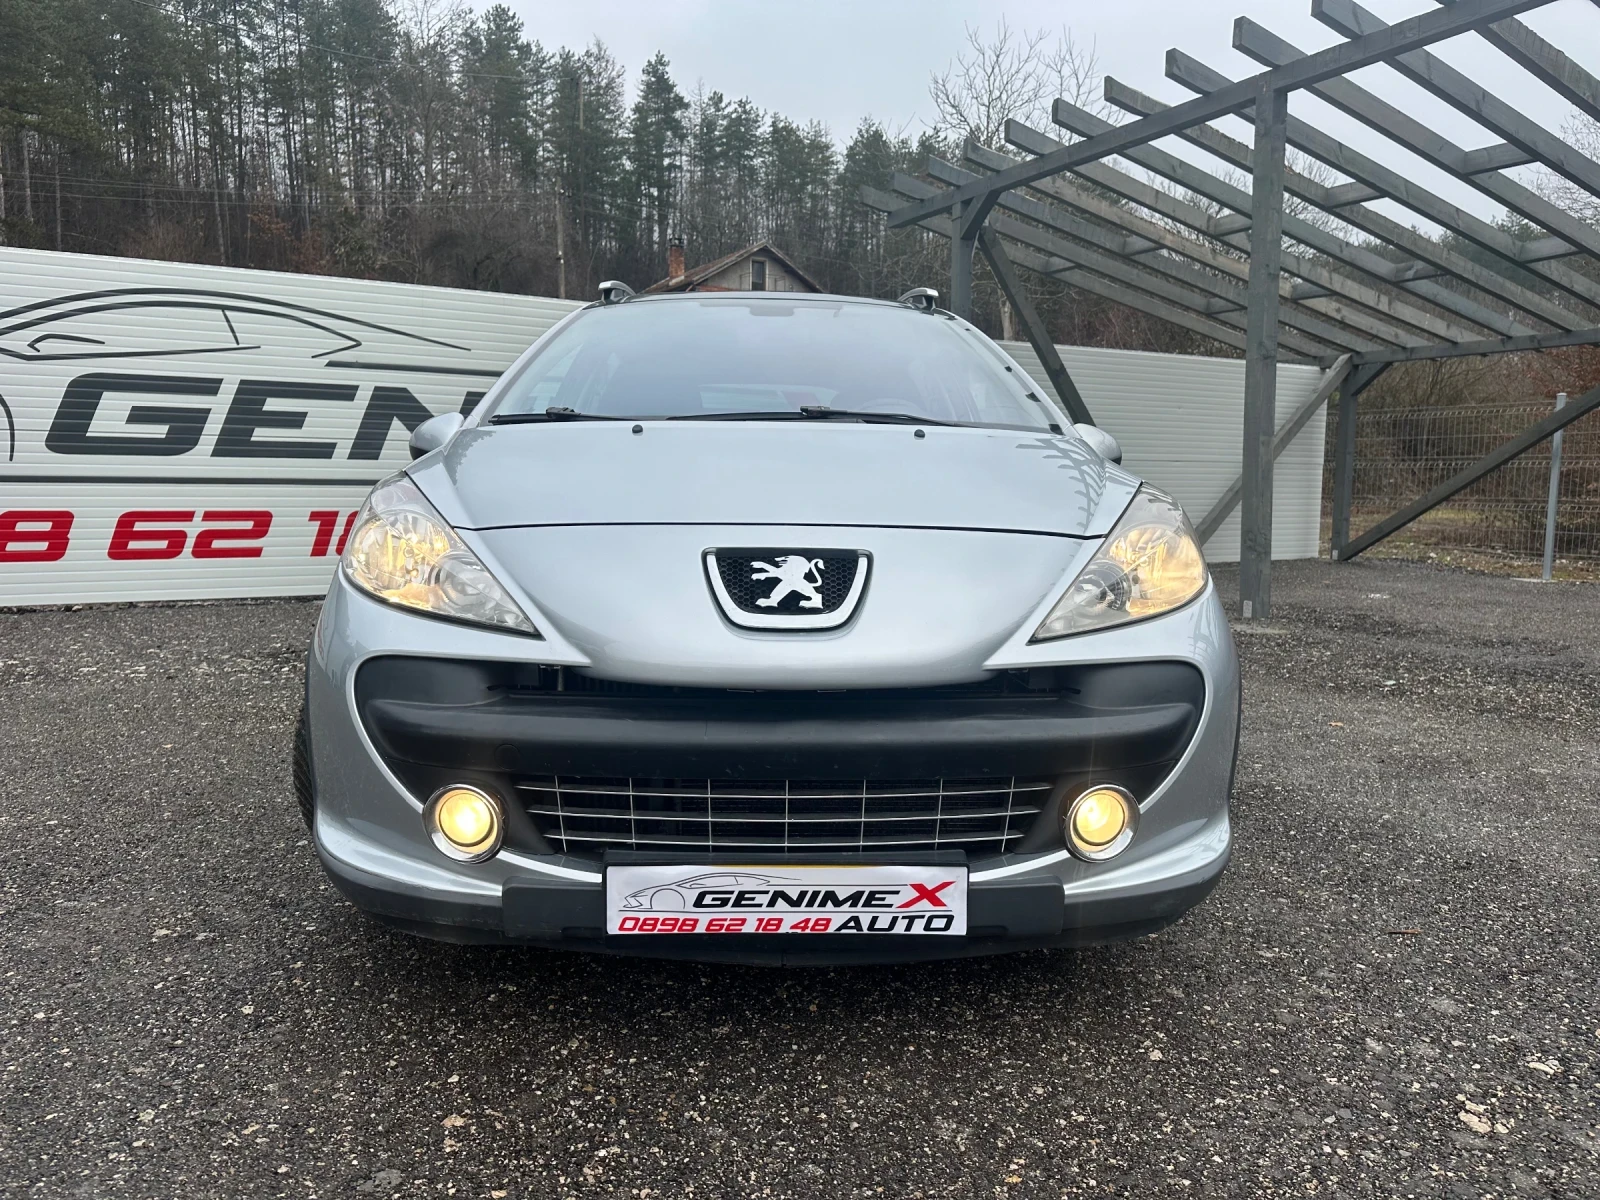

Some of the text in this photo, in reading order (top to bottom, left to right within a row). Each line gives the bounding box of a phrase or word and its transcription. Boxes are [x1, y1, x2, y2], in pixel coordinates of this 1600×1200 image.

[107, 510, 272, 558] 62
[692, 881, 956, 909] GENIMEX
[618, 914, 955, 932] 0898 62 18 48 AUTO
